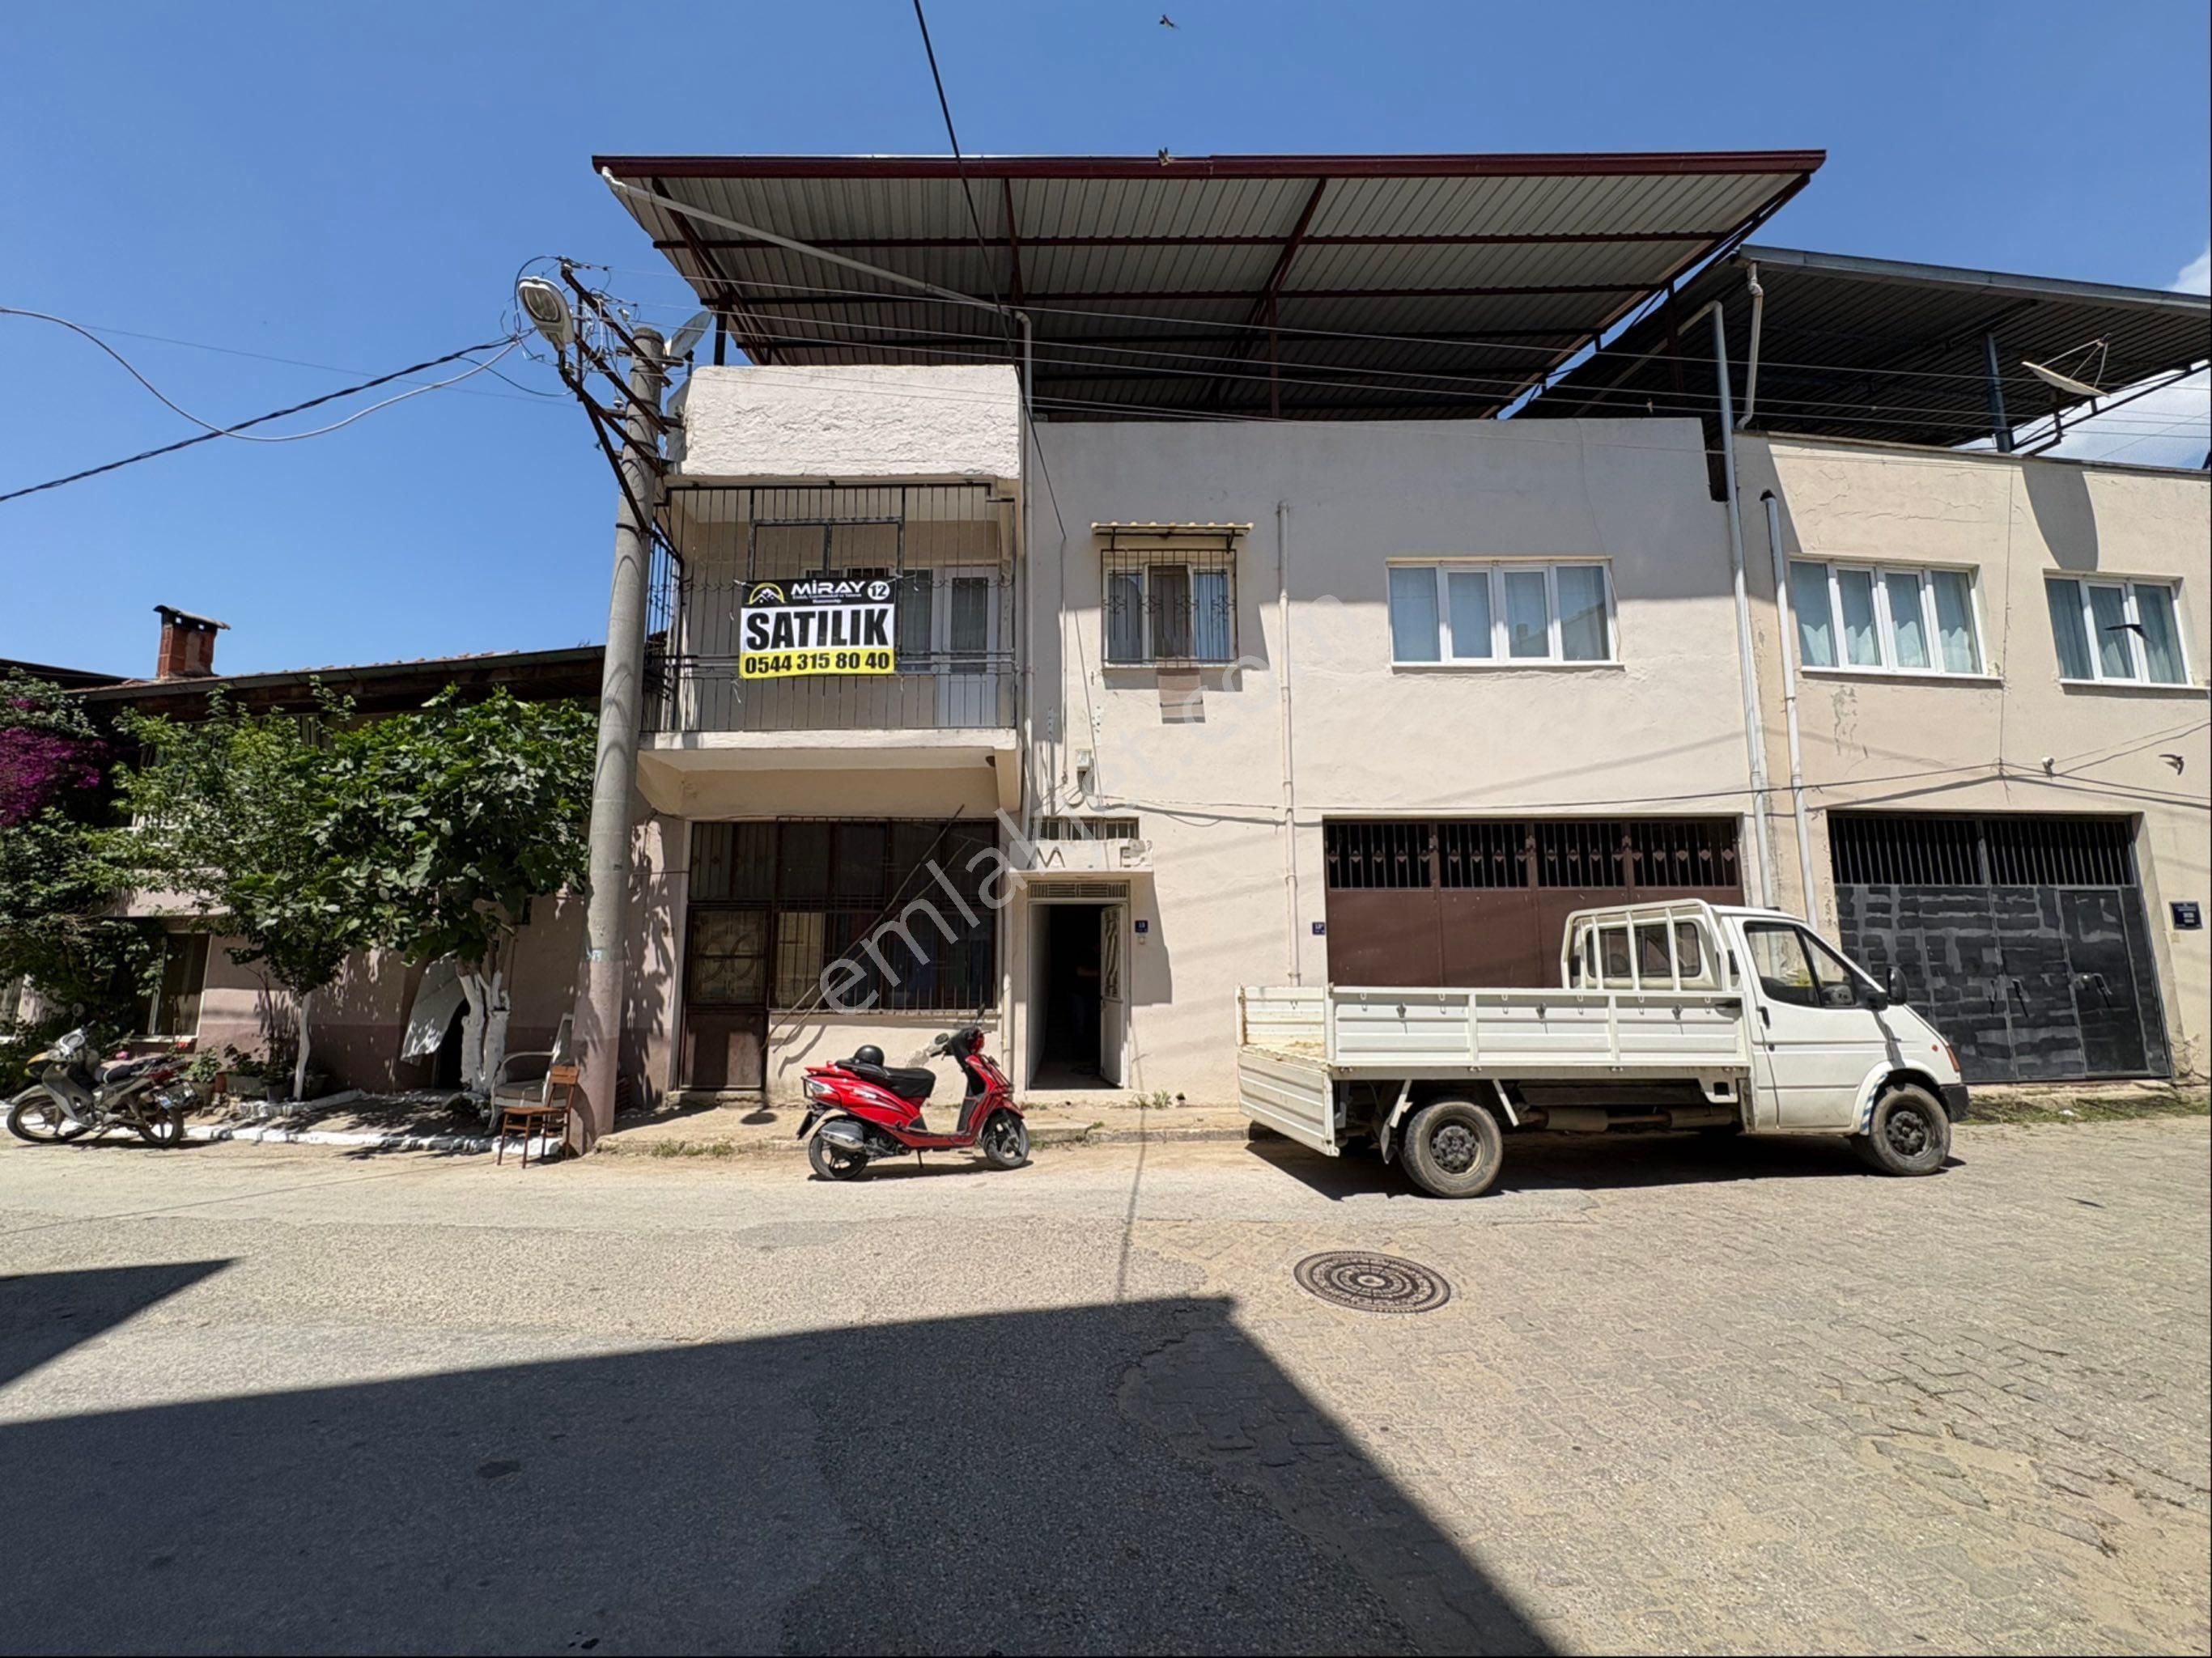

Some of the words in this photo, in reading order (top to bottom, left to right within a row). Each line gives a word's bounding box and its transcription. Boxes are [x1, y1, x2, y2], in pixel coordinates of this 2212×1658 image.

[791, 579, 866, 596] MİRAY
[869, 584, 887, 598] 12
[746, 608, 889, 651] SATILIK
[745, 655, 792, 674] 0544
[796, 652, 830, 670] 315
[835, 652, 860, 670] 80
[865, 652, 890, 670] 40
